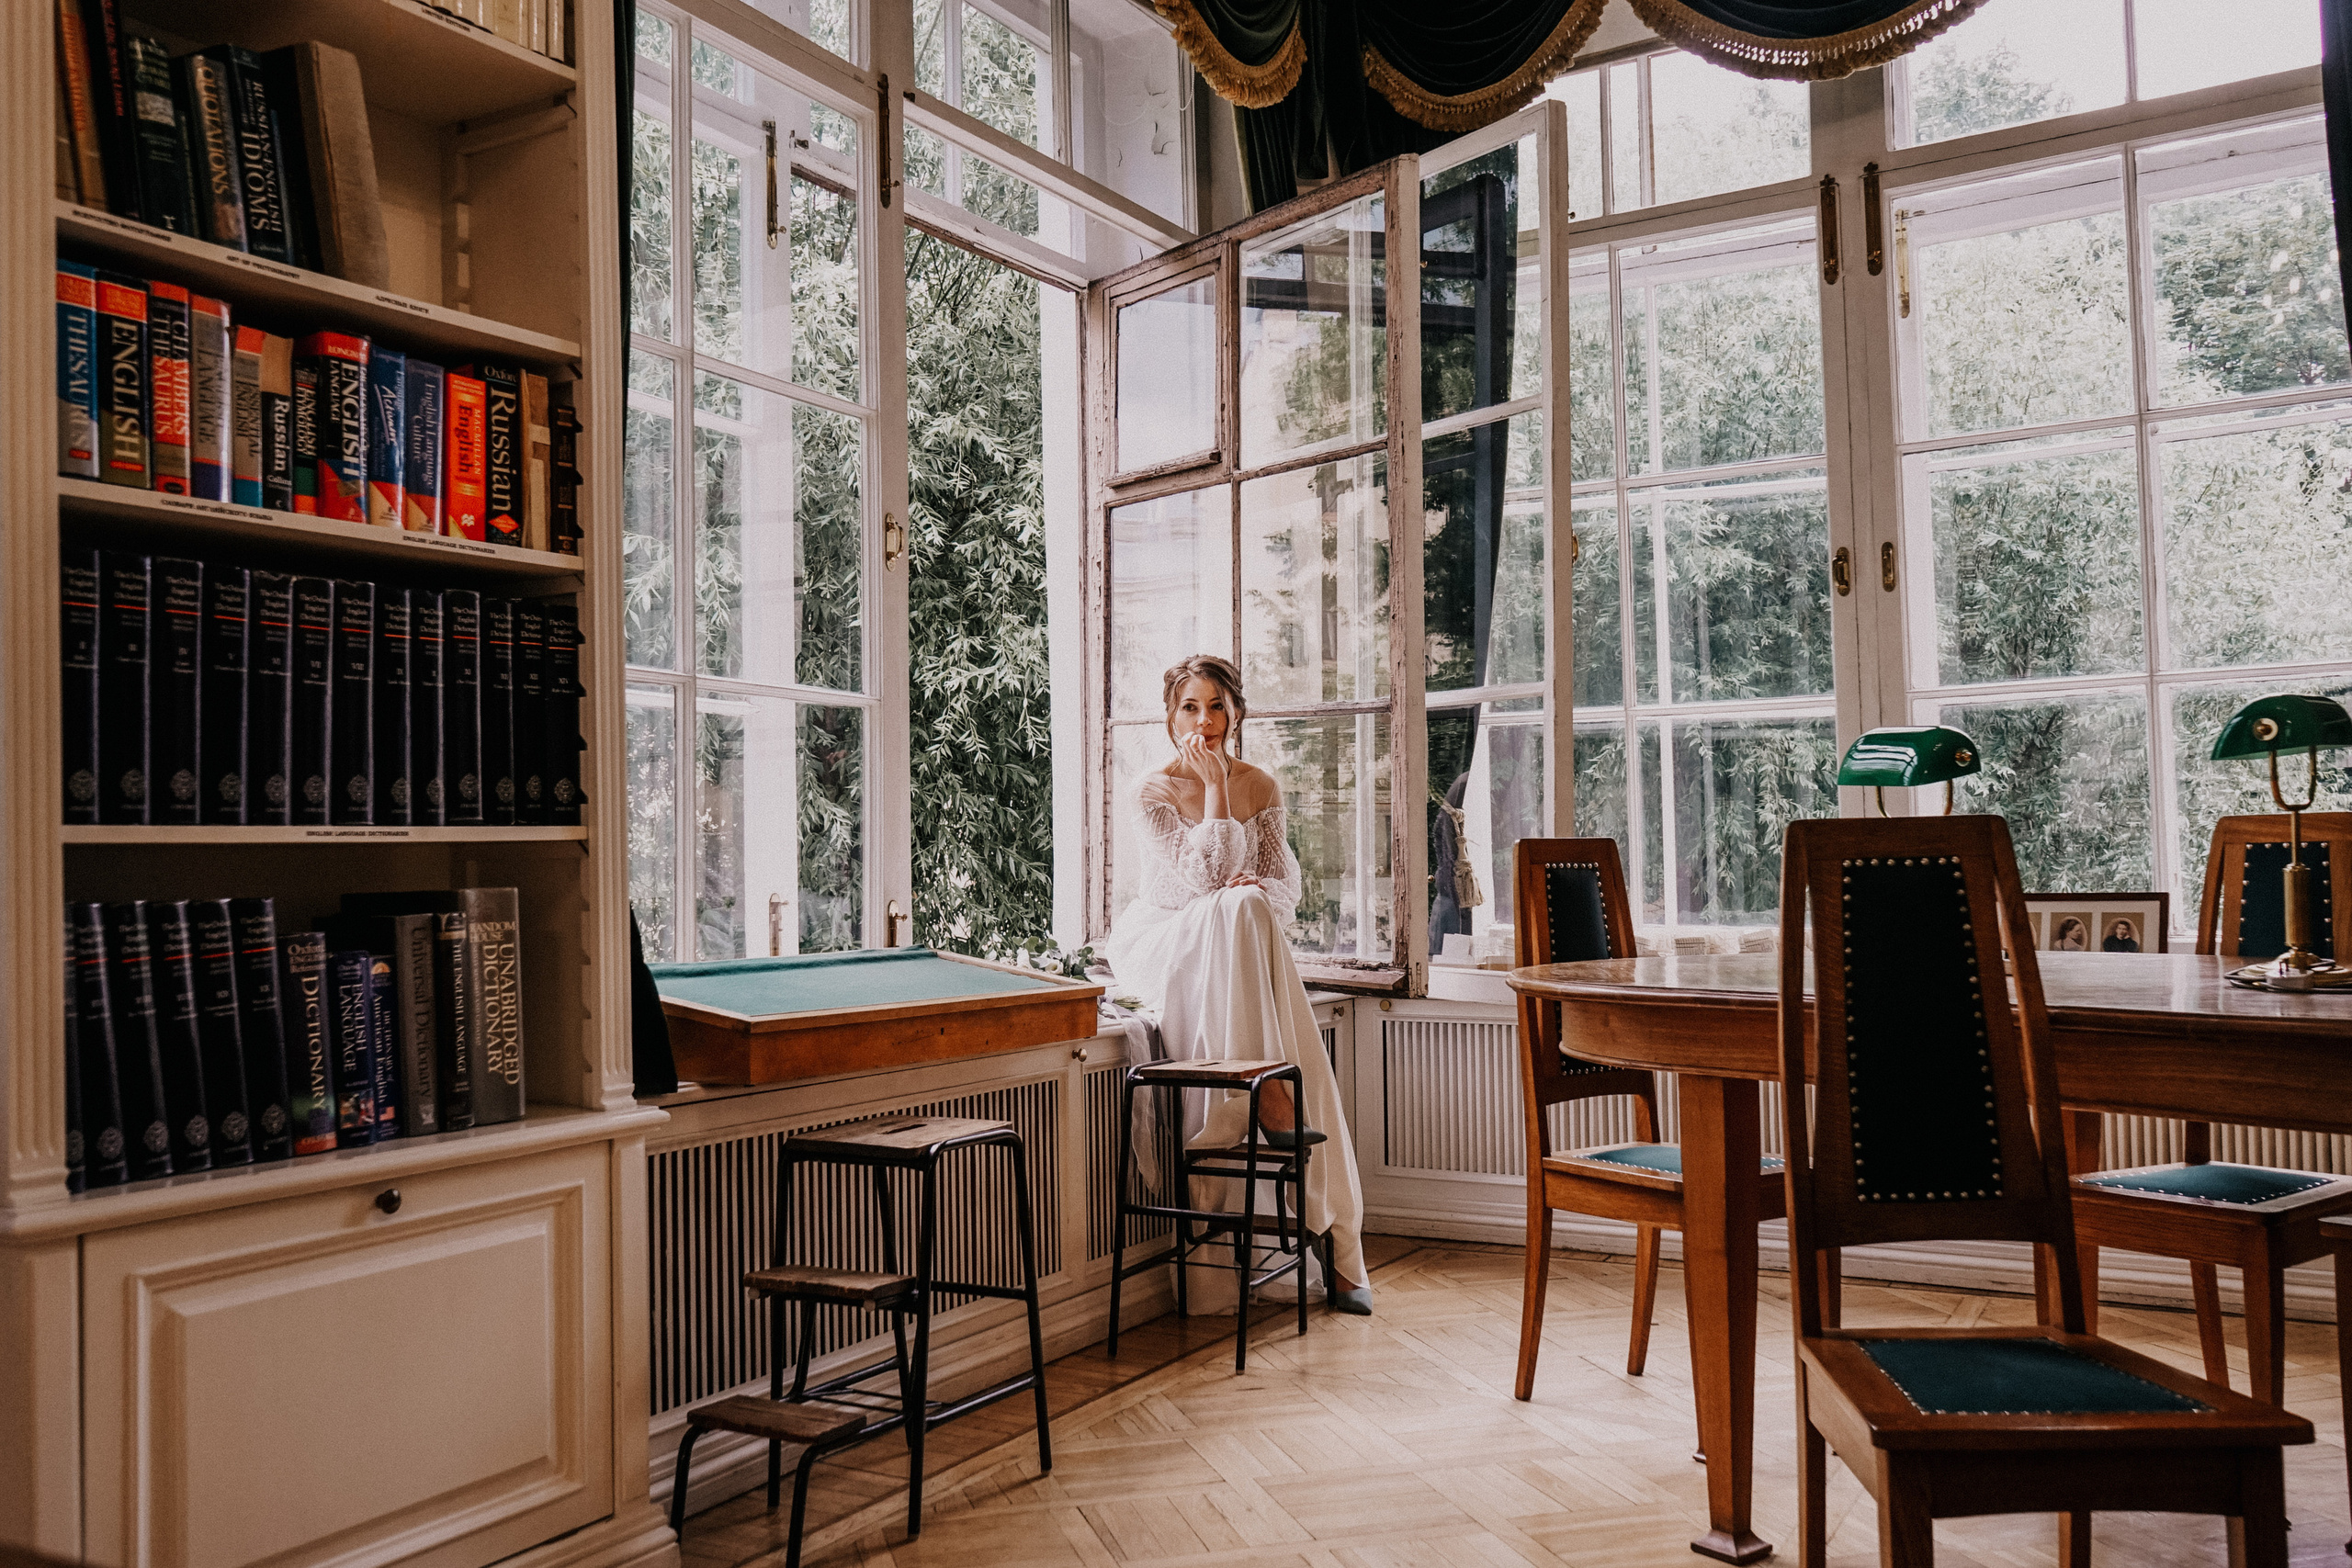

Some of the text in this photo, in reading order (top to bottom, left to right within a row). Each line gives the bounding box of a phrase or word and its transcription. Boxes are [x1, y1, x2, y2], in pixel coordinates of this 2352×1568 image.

[202, 66, 230, 196] QUOTATIONS
[241, 130, 272, 231] IDIOMS
[67, 310, 91, 448] THESAURUS
[111, 318, 141, 460] ENGLISH
[328, 359, 341, 423] LANGUAGE
[272, 398, 291, 473] Russian
[304, 388, 319, 457] ENGLISH
[340, 361, 361, 477] ENGLISH
[411, 414, 424, 465] Culture
[421, 382, 438, 491] English Language
[454, 404, 475, 474] English
[472, 408, 483, 477] MACMILLAN
[490, 387, 518, 513] Russian
[402, 535, 496, 556] ENGLISH LANGUAGE DICTIONARIES
[306, 829, 410, 838] ENGLISH LANGUAGE DICTIONARIES
[452, 943, 464, 963] THE
[469, 920, 516, 934] RANDOM
[351, 983, 368, 1052] ENGLISH
[372, 993, 384, 1055] American
[412, 926, 432, 1100] Universal Dictionary
[452, 966, 465, 1014] ENGLISH
[482, 944, 504, 1075] DICTIONARY
[499, 942, 521, 1086] UNABRIDGED
[300, 975, 327, 1111] DICTIONARY
[338, 984, 359, 1073] LANGUAGE
[454, 1016, 467, 1074] LANGUAGE
[375, 1056, 390, 1104] English
